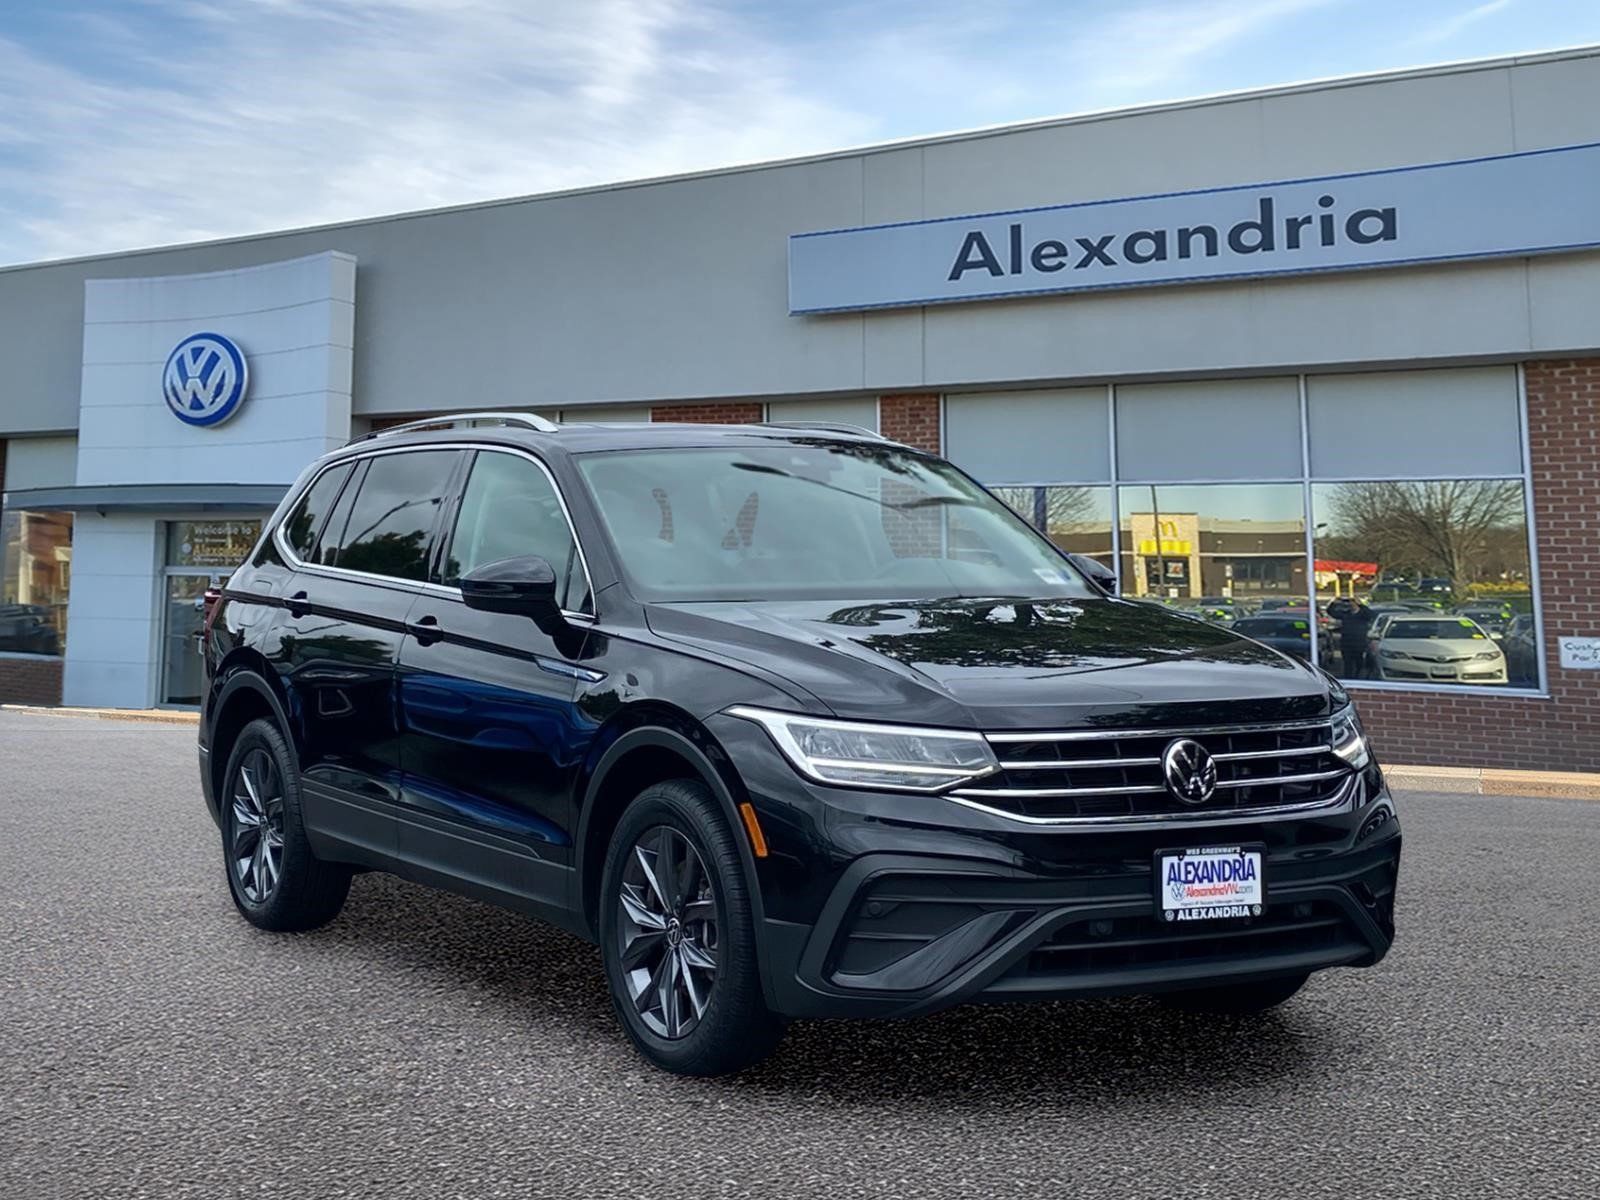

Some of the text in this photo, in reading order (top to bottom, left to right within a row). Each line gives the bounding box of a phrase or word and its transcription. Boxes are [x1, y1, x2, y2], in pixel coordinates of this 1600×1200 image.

[948, 195, 1397, 281] Alexandria
[166, 337, 239, 419] VW
[1167, 858, 1256, 886] ALEXANDRIA
[1177, 905, 1250, 920] ALEXANDRIA
